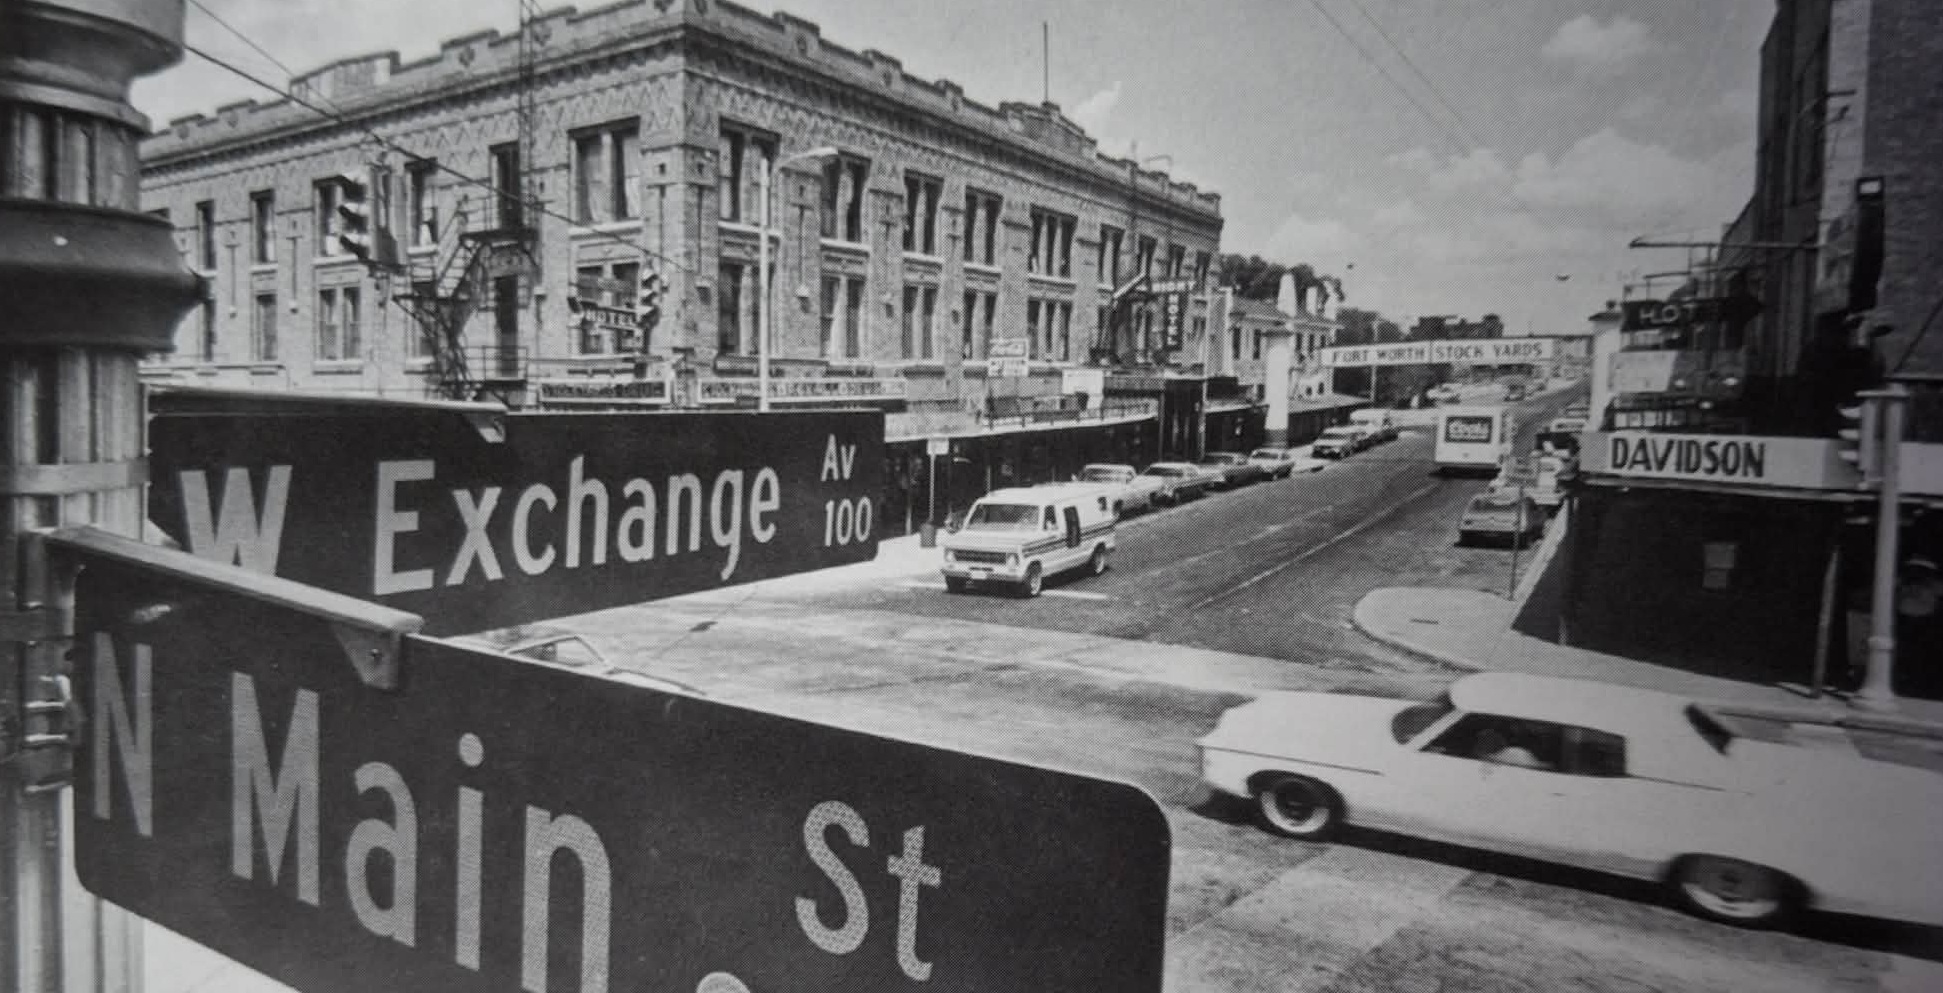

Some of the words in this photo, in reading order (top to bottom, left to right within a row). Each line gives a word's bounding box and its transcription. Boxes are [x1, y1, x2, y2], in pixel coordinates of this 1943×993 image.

[585, 310, 637, 328] HOTEL
[1167, 294, 1179, 345] HOTEL
[1333, 350, 1369, 364] FORT
[1377, 346, 1426, 361] WORTH
[1435, 344, 1485, 361] STOCK
[1493, 342, 1543, 358] YARDS
[821, 434, 859, 482] Av
[1611, 437, 1765, 478] DAVIDSON
[180, 464, 292, 579] W
[372, 455, 782, 597] Exchange
[823, 496, 873, 547] 100
[93, 631, 153, 838] N
[231, 671, 612, 993] Main
[795, 800, 942, 982] St
